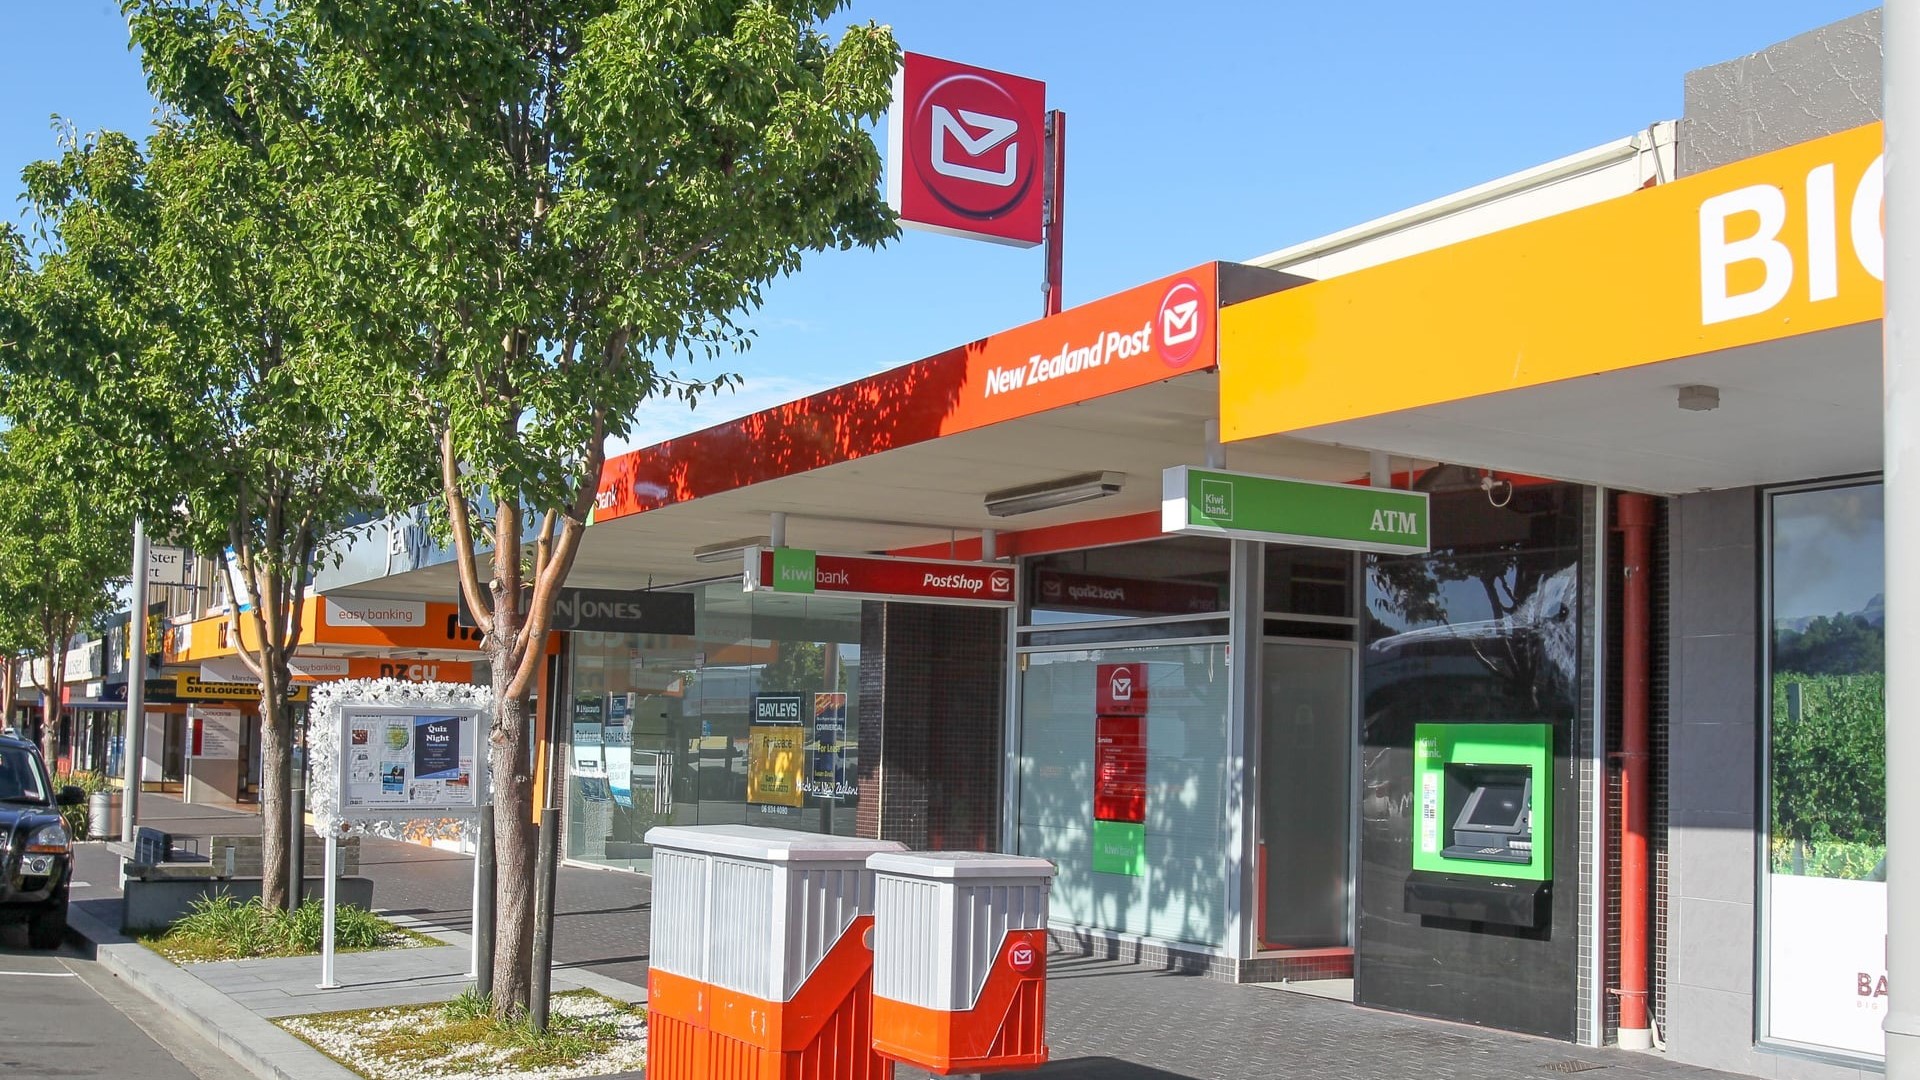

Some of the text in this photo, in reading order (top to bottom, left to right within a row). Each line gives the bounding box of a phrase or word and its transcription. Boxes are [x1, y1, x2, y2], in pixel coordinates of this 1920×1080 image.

[984, 321, 1152, 398] New Zealand Post
[1205, 493, 1224, 504] Kiwi
[1205, 504, 1229, 516] bank.
[1369, 509, 1418, 535] ATM
[150, 550, 177, 564] ster
[150, 569, 160, 578] rt
[781, 565, 850, 585] kiwi bank
[923, 573, 984, 593] PostShop
[338, 608, 413, 622] easy banking
[311, 662, 341, 672] banking
[759, 702, 798, 717] BAYLEYS
[427, 724, 448, 734] Quiz
[425, 734, 450, 742] Night
